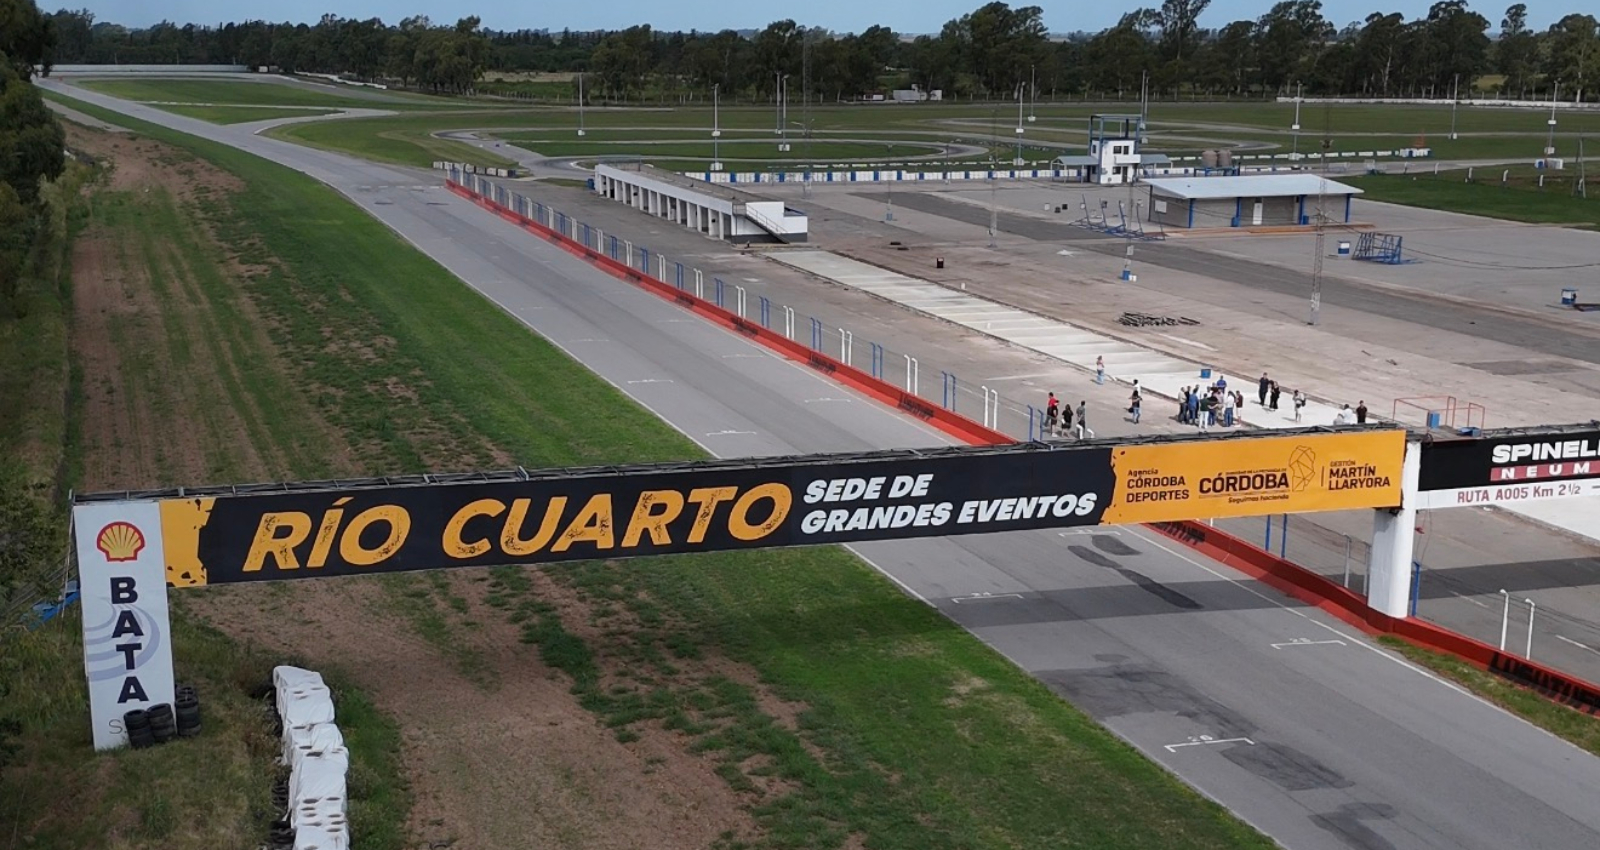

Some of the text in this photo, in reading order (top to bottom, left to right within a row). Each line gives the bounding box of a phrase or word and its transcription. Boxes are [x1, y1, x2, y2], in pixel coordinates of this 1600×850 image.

[1491, 439, 1600, 463] SPINEL
[1128, 468, 1158, 477] Agencia
[1329, 463, 1376, 479] MARTÍN
[803, 474, 934, 504] SEDE DE
[1127, 475, 1186, 489] CÓRDOBA
[1199, 472, 1289, 494] CÓRDOBA
[1328, 476, 1391, 491] LLARYORA
[1126, 489, 1190, 503] DEPORTES
[1457, 489, 1490, 503] RUTA
[1495, 487, 1529, 501] A005
[1533, 485, 1554, 498] Km
[800, 492, 1098, 535] GRANDES EVENTOS
[242, 482, 793, 572] RÍO CUARTO
[110, 576, 149, 704] BATA
